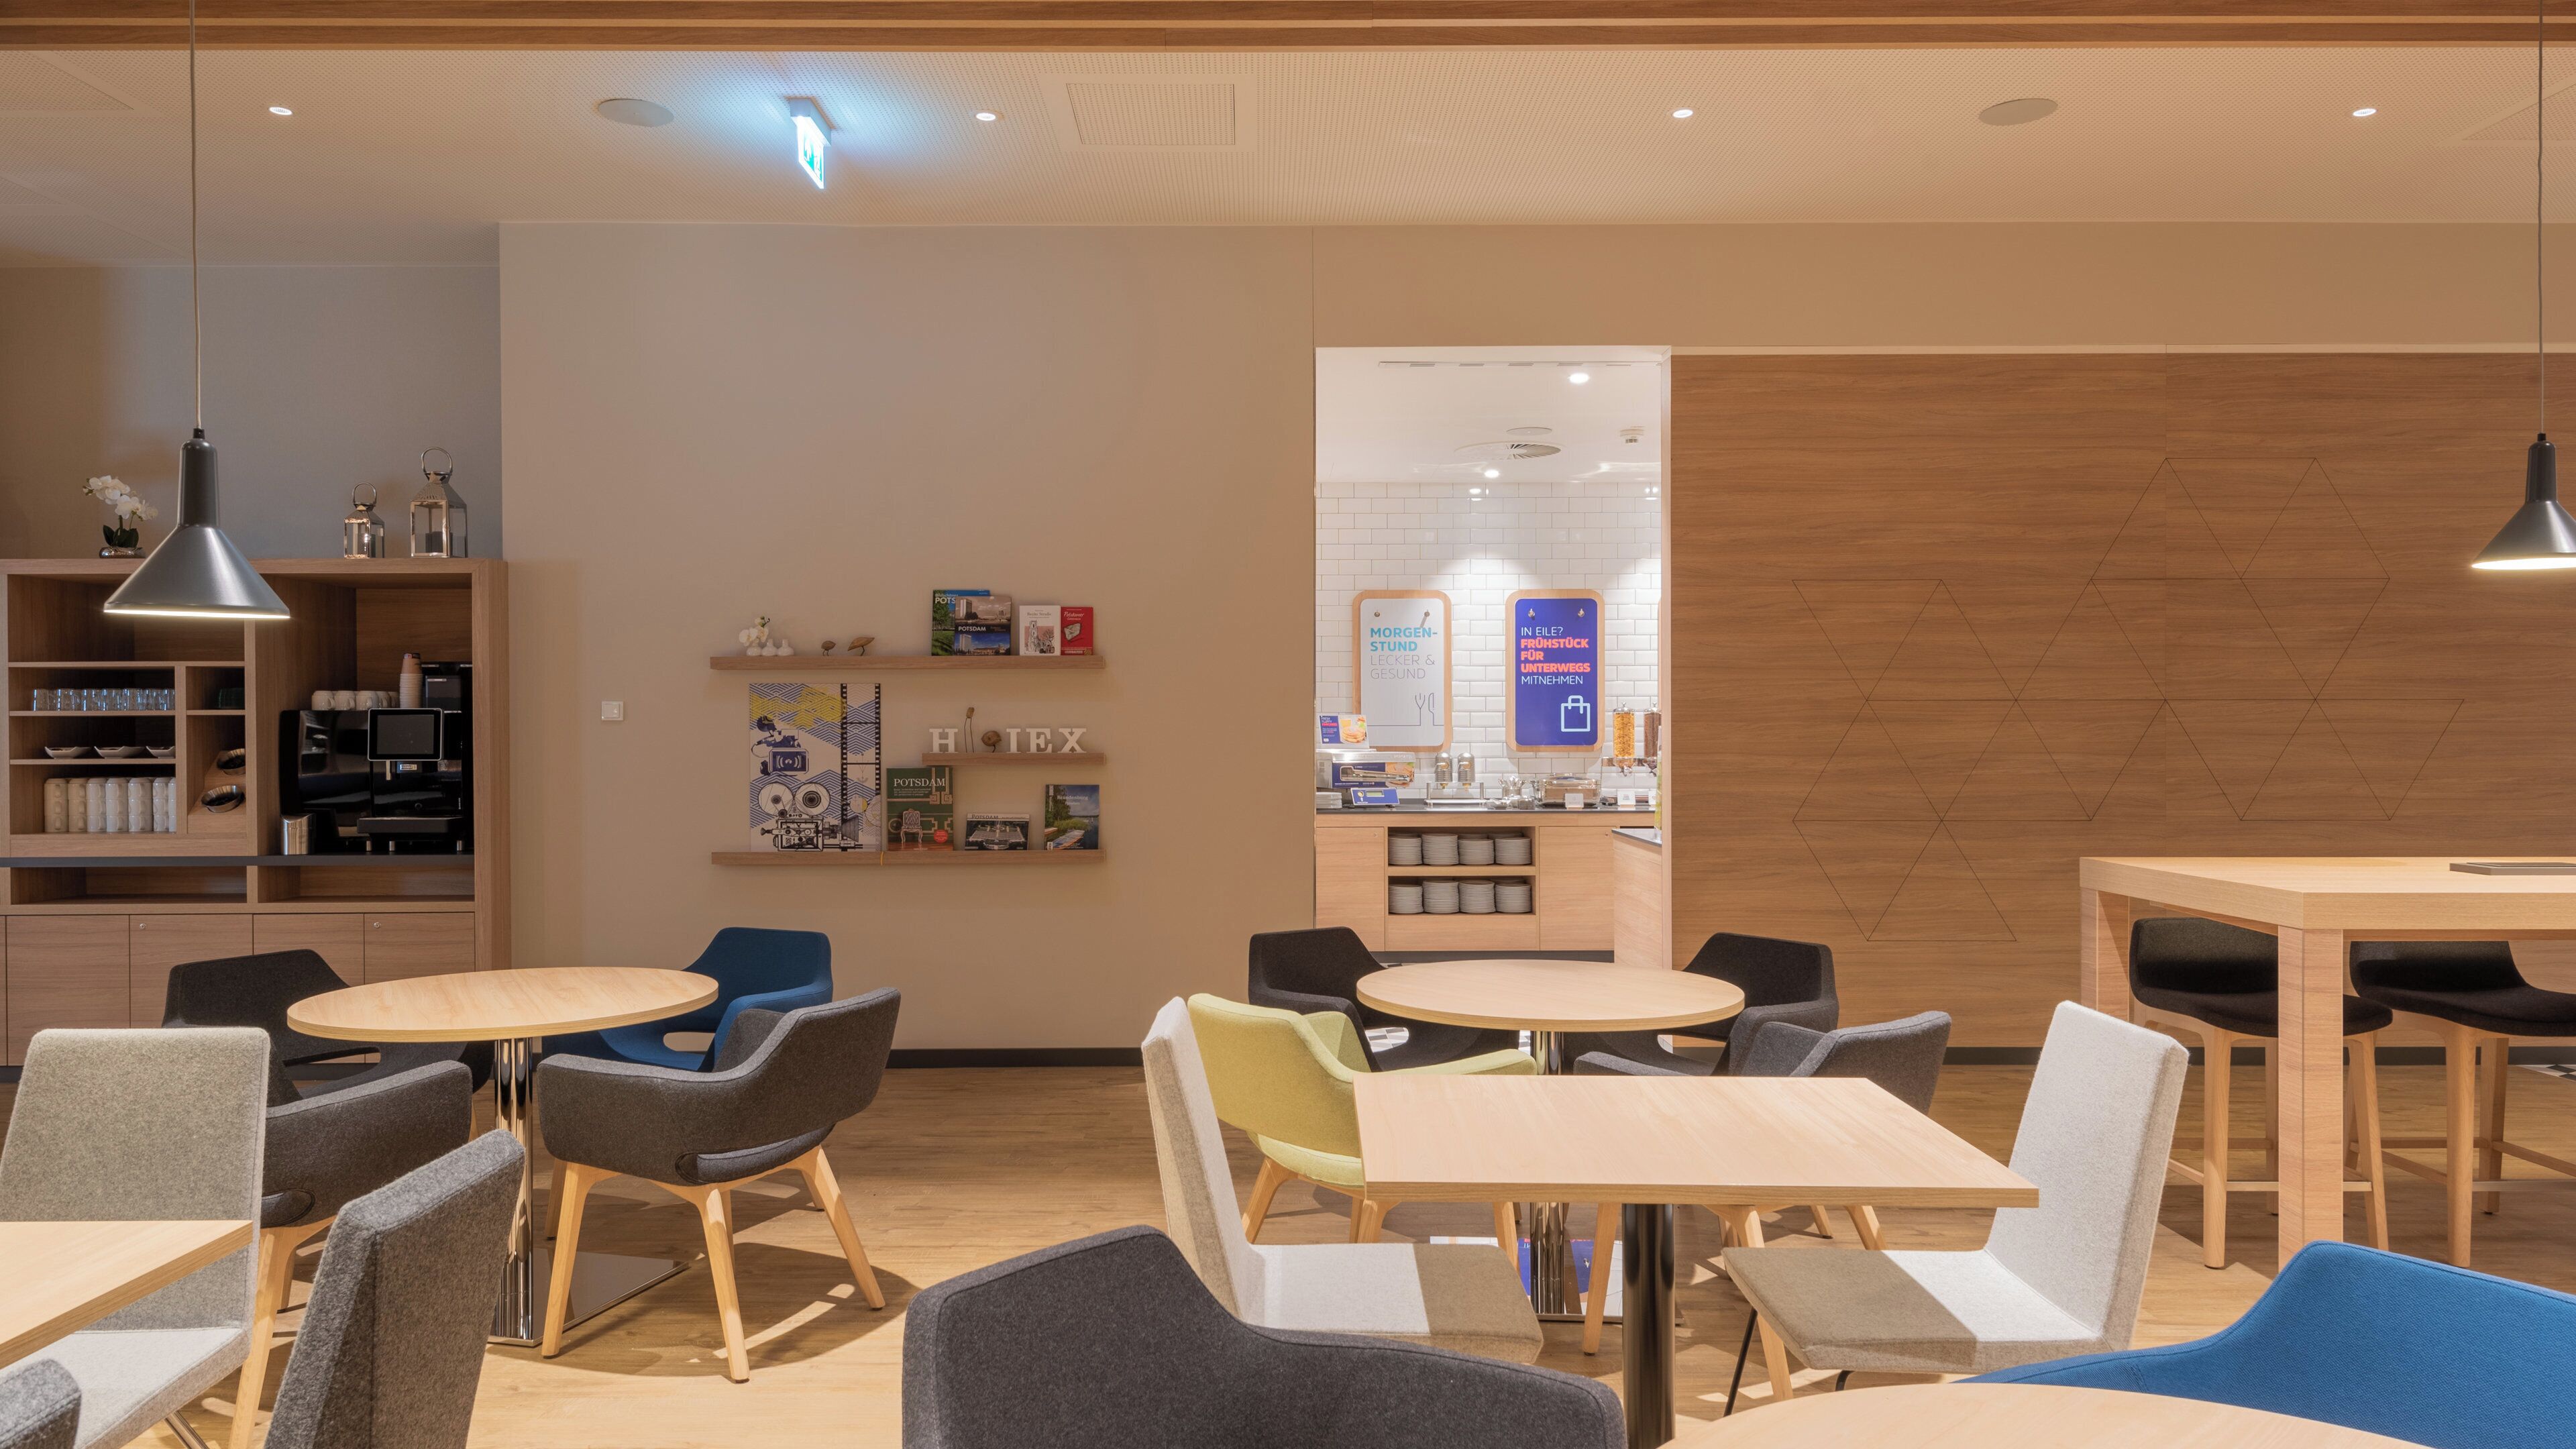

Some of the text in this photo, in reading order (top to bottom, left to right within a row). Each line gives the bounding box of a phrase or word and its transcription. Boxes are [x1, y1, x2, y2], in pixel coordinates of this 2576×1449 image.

[1370, 627, 1438, 638] MORGEN-
[1521, 627, 1564, 637] IN EILE?
[1370, 641, 1417, 652] STUND
[1521, 637, 1589, 649] FRÜHSTÜCK
[1371, 654, 1436, 665] LECKER &
[1521, 649, 1544, 661] FÜR
[1521, 662, 1591, 673] UNTERWEGS
[1370, 668, 1426, 680] GESUND
[1521, 675, 1584, 685] MITNEHMEN
[894, 778, 946, 787] POTSDAM
